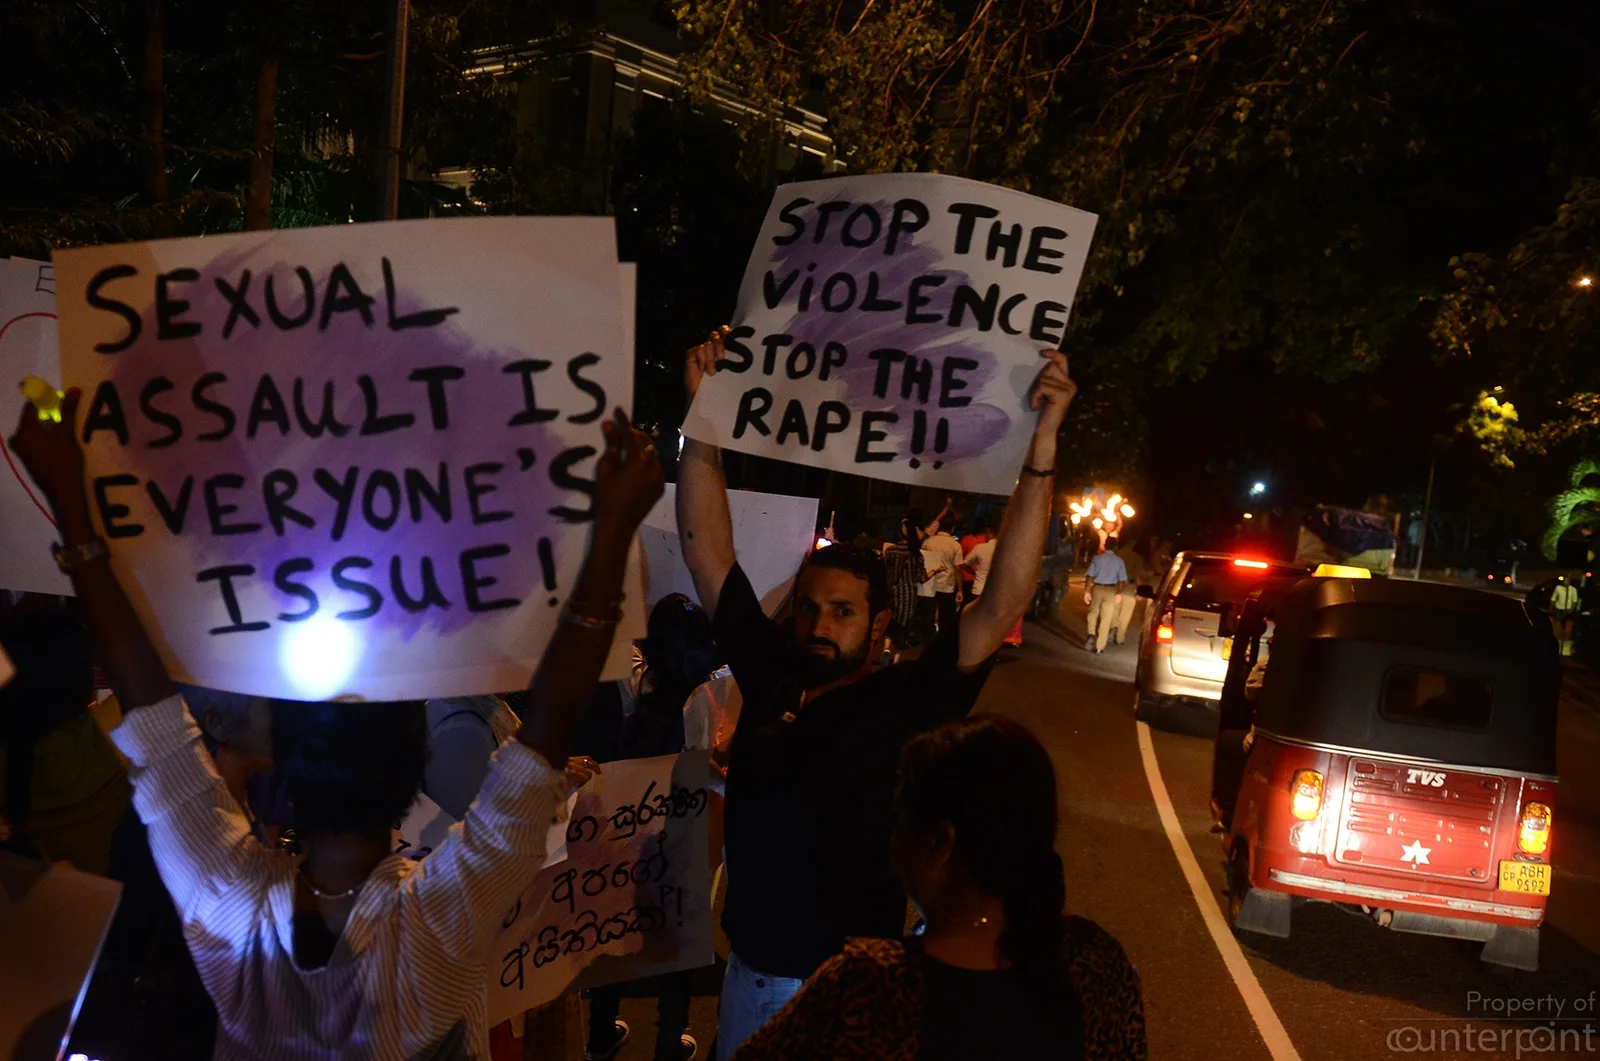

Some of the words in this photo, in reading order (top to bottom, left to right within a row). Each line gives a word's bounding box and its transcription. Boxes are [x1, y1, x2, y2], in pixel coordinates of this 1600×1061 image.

[772, 197, 930, 255] STOP
[948, 202, 1069, 274] THE
[86, 256, 459, 354] SEXUAL
[82, 366, 465, 448] ASSAULT
[503, 352, 608, 427] IS
[716, 325, 848, 381] STOP
[868, 348, 979, 408] THE
[732, 387, 950, 470] RAPE!!
[93, 446, 597, 541] EVERYONE'S
[197, 537, 560, 635] ISSUE!
[1406, 768, 1447, 788] TVS
[1519, 865, 1545, 879] ABH
